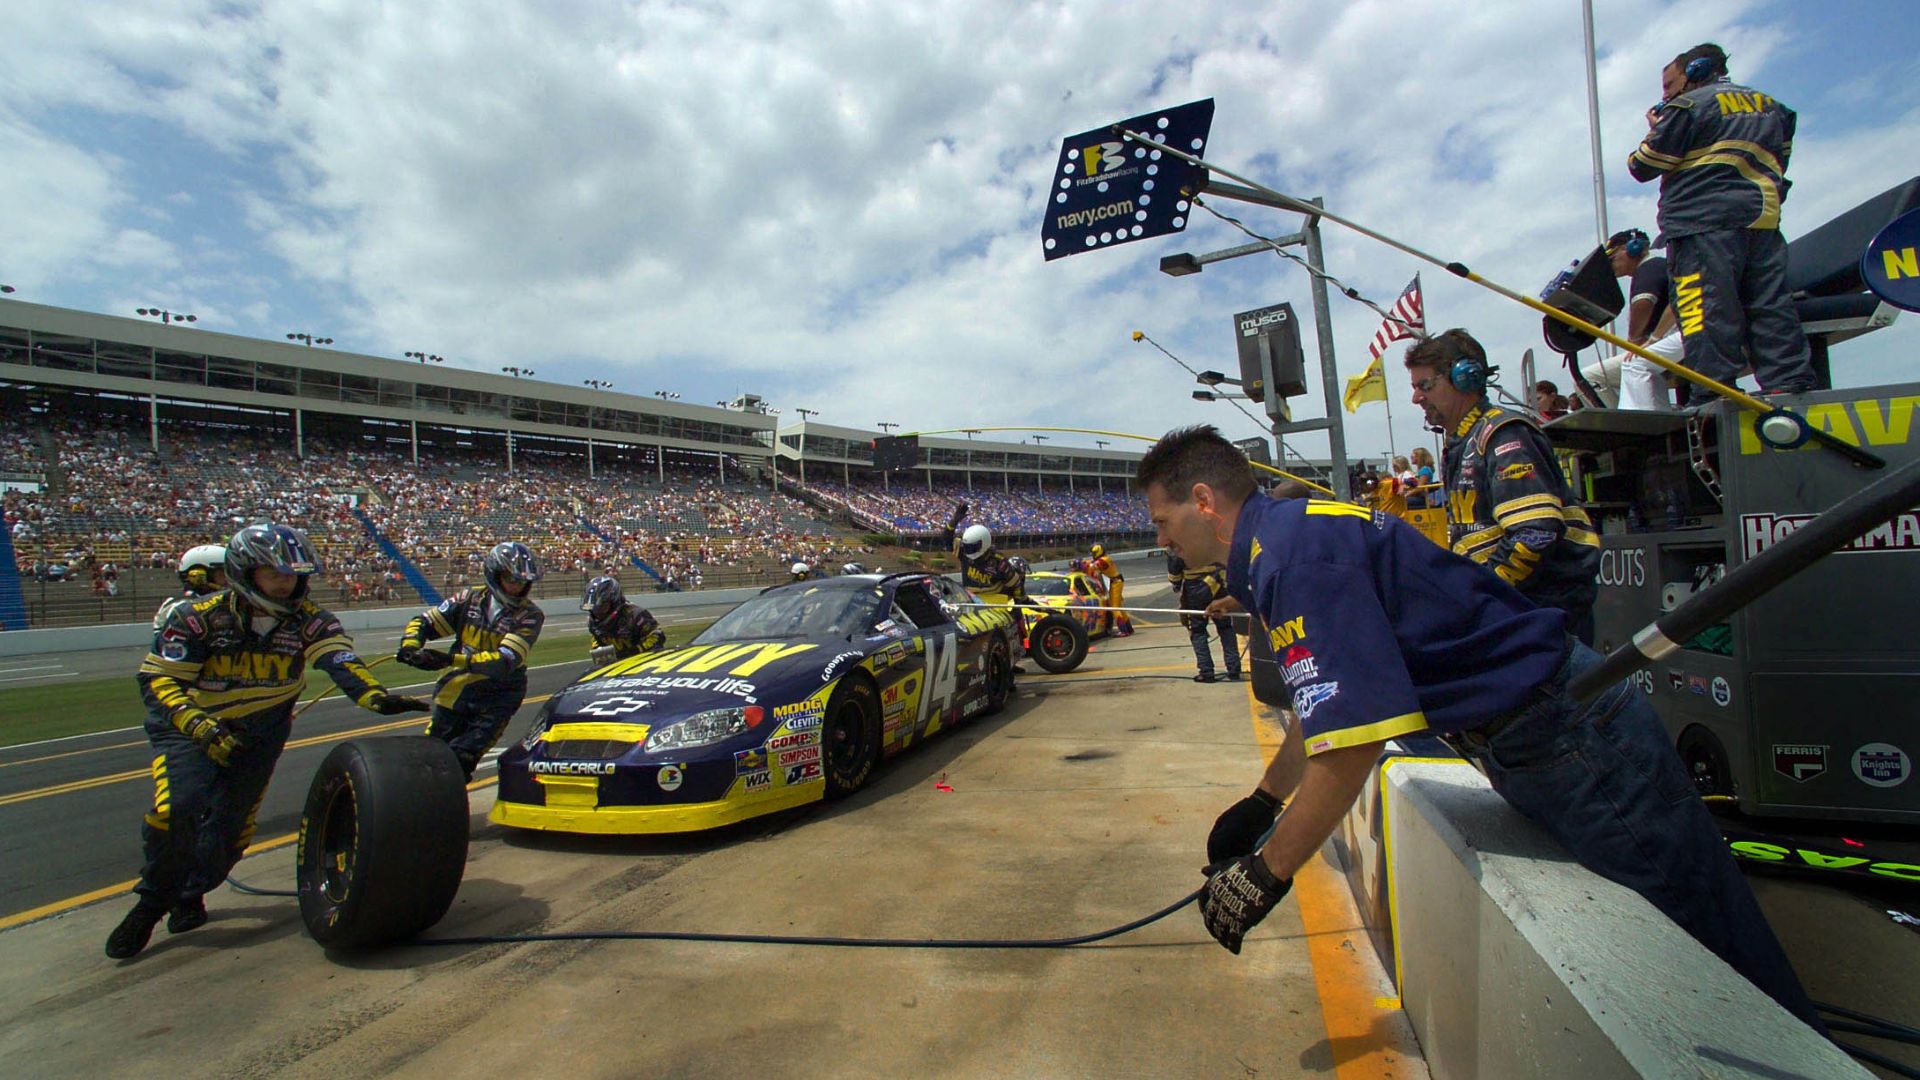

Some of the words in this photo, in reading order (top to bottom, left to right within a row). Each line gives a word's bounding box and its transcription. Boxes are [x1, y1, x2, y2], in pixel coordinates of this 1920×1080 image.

[1057, 199, 1134, 230] navy.com
[1673, 272, 1704, 337] NAVY
[1457, 406, 1481, 437] NAVY
[967, 566, 992, 584] NAVY
[203, 652, 293, 680] NAVY
[577, 643, 819, 682] NAVY
[656, 678, 717, 690] your
[917, 632, 957, 722] 14
[884, 686, 898, 704] 3M
[773, 698, 822, 718] MOOG
[786, 717, 821, 730] CLEVITE
[771, 732, 809, 750] COMP
[780, 746, 819, 765] SIMPSON
[1776, 747, 1822, 755] FERRIS
[528, 762, 568, 774] MONTE
[569, 763, 616, 775] CARLO
[1861, 760, 1900, 770] Knights
[1873, 768, 1890, 777] Inn
[745, 771, 770, 788] WIX
